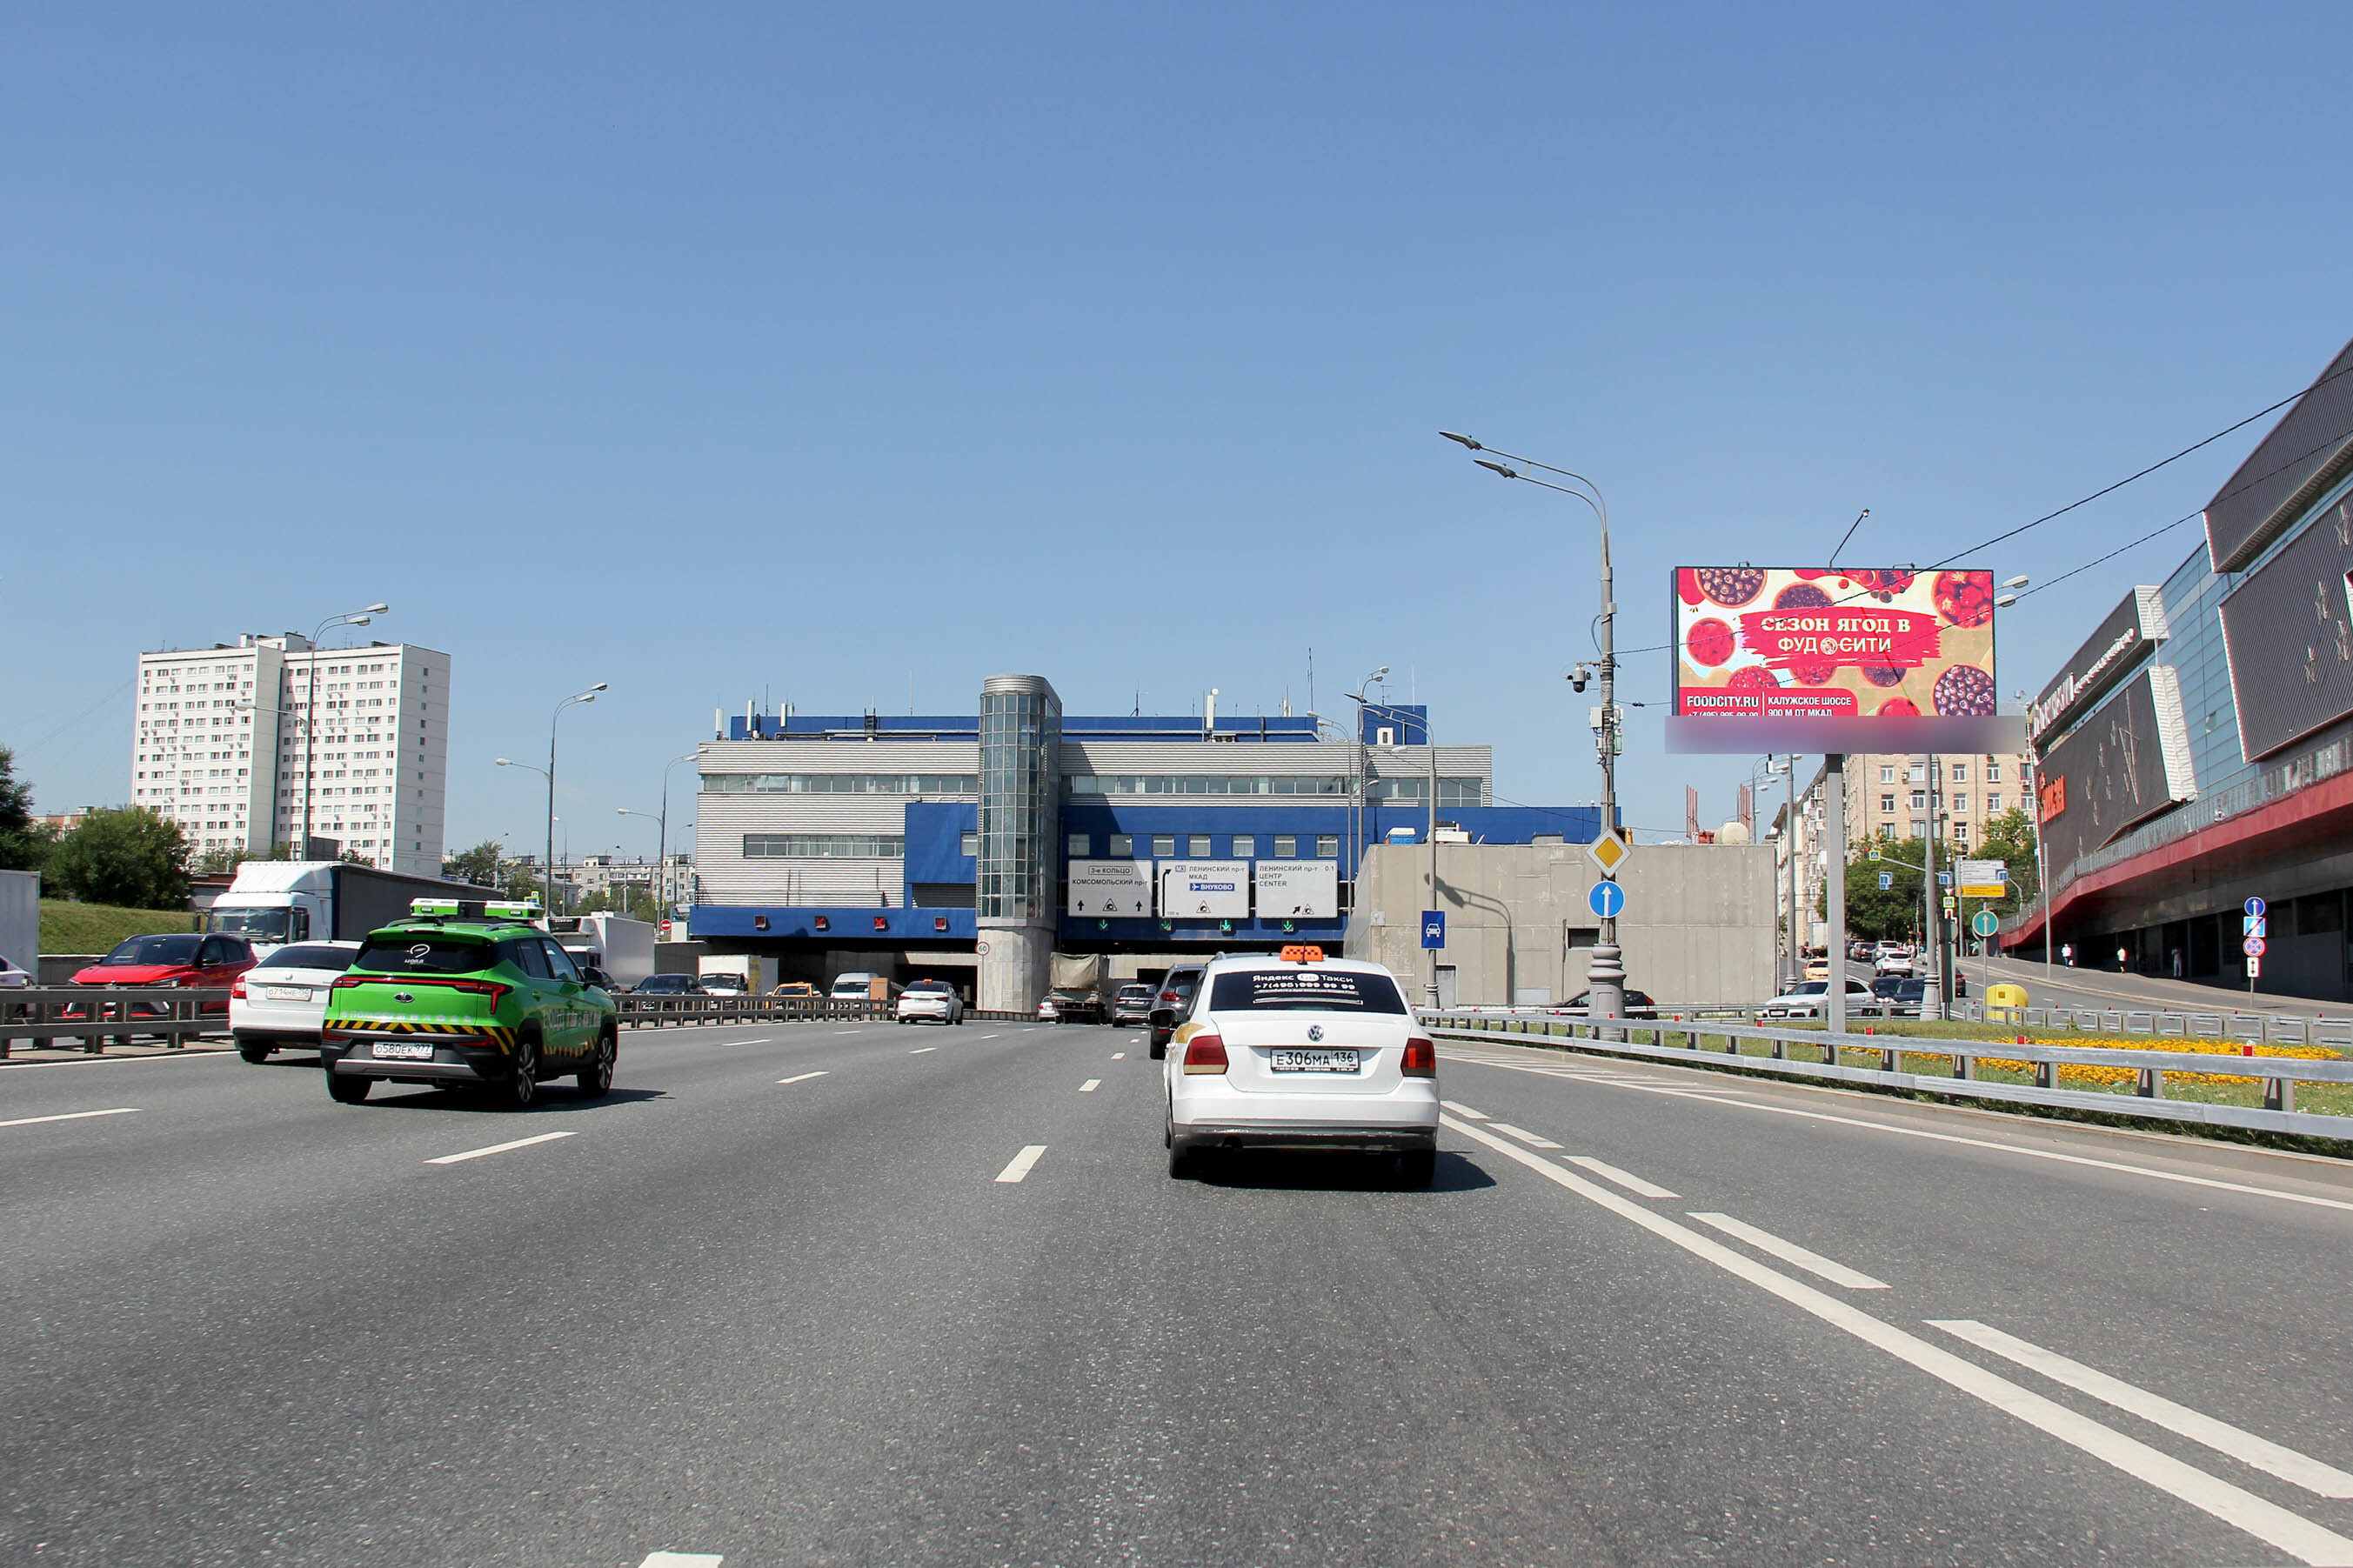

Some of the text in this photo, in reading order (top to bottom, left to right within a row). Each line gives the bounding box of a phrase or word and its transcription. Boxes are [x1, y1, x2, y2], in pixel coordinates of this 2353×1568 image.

[1761, 617, 1910, 633] СЕЗОН ЯГОД В
[1778, 637, 1891, 654] ФУД СИТИ
[1687, 696, 1759, 707] FOODCITY.RU
[1768, 697, 1851, 705] КАЛУЖСКОЕ ШОССЕ
[1334, 1052, 1354, 1063] 136
